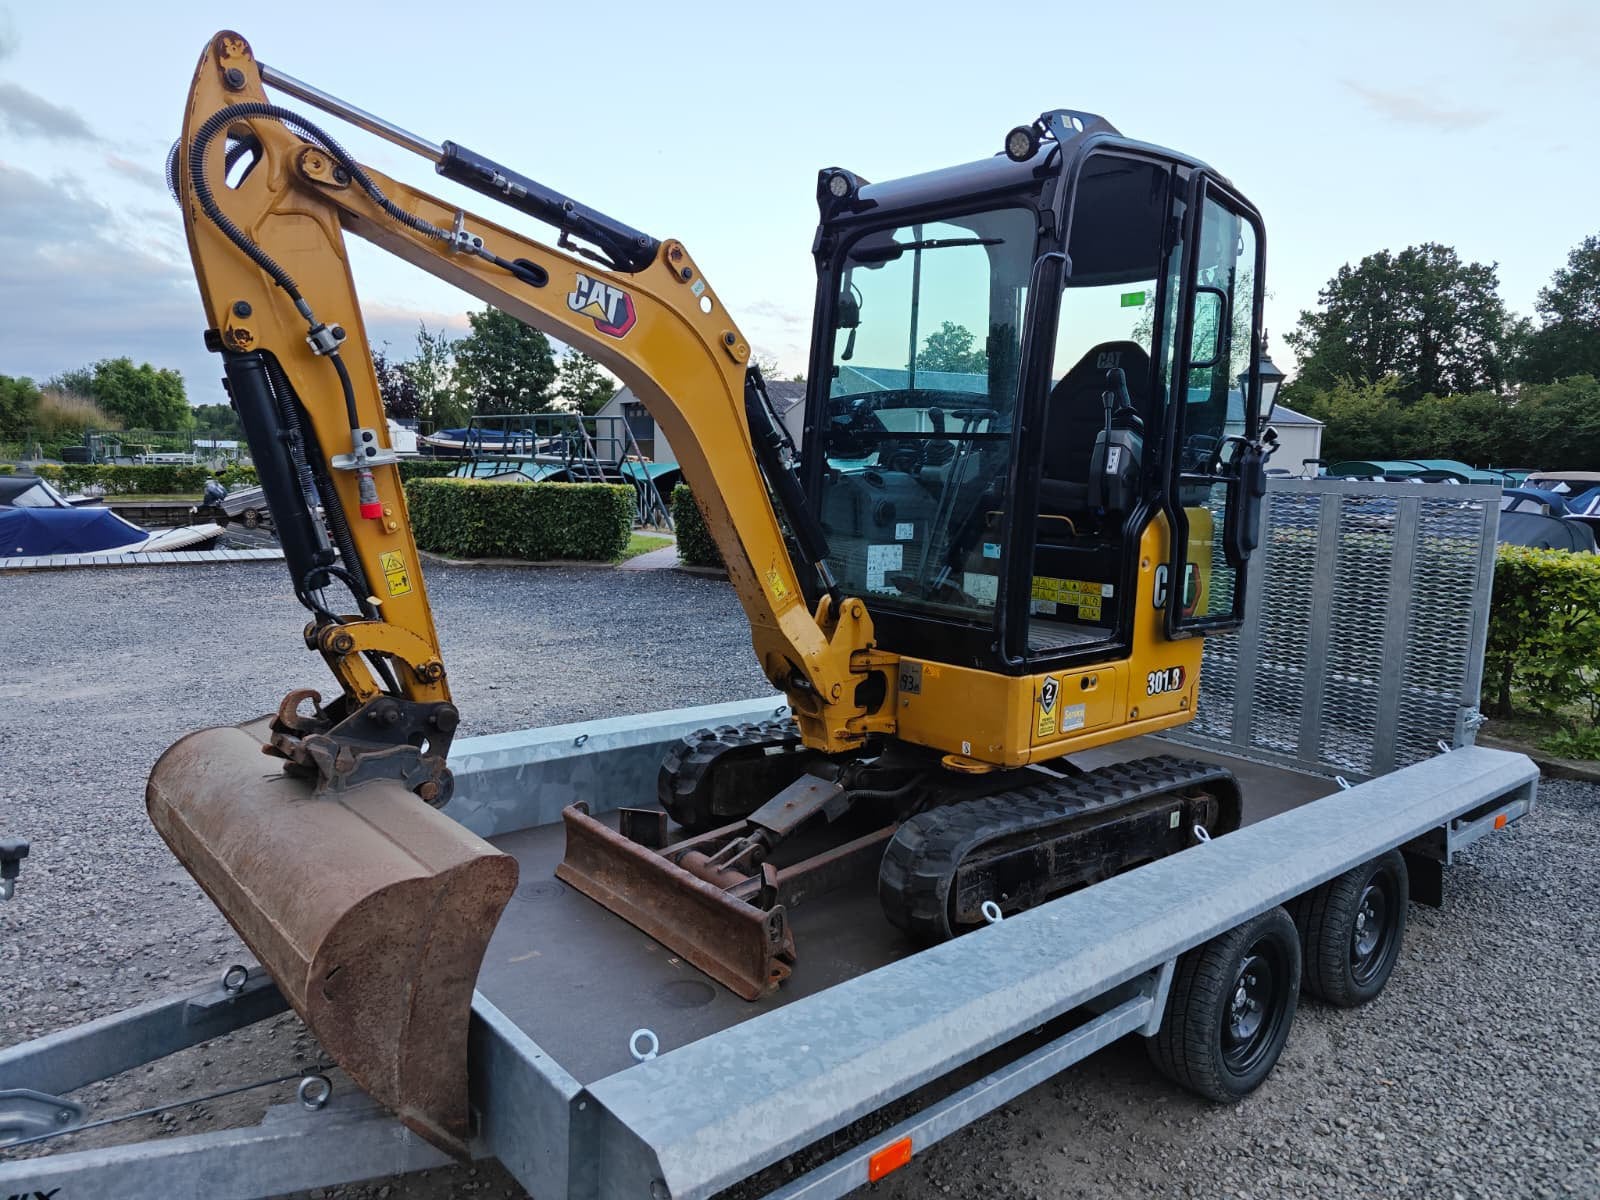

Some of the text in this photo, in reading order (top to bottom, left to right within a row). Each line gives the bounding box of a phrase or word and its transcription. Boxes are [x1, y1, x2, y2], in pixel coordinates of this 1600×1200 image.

[568, 273, 624, 324] CAT
[1097, 351, 1122, 368] CAT
[1154, 564, 1193, 609] CT
[1045, 684, 1053, 699] 2
[1146, 668, 1181, 695] 301.8
